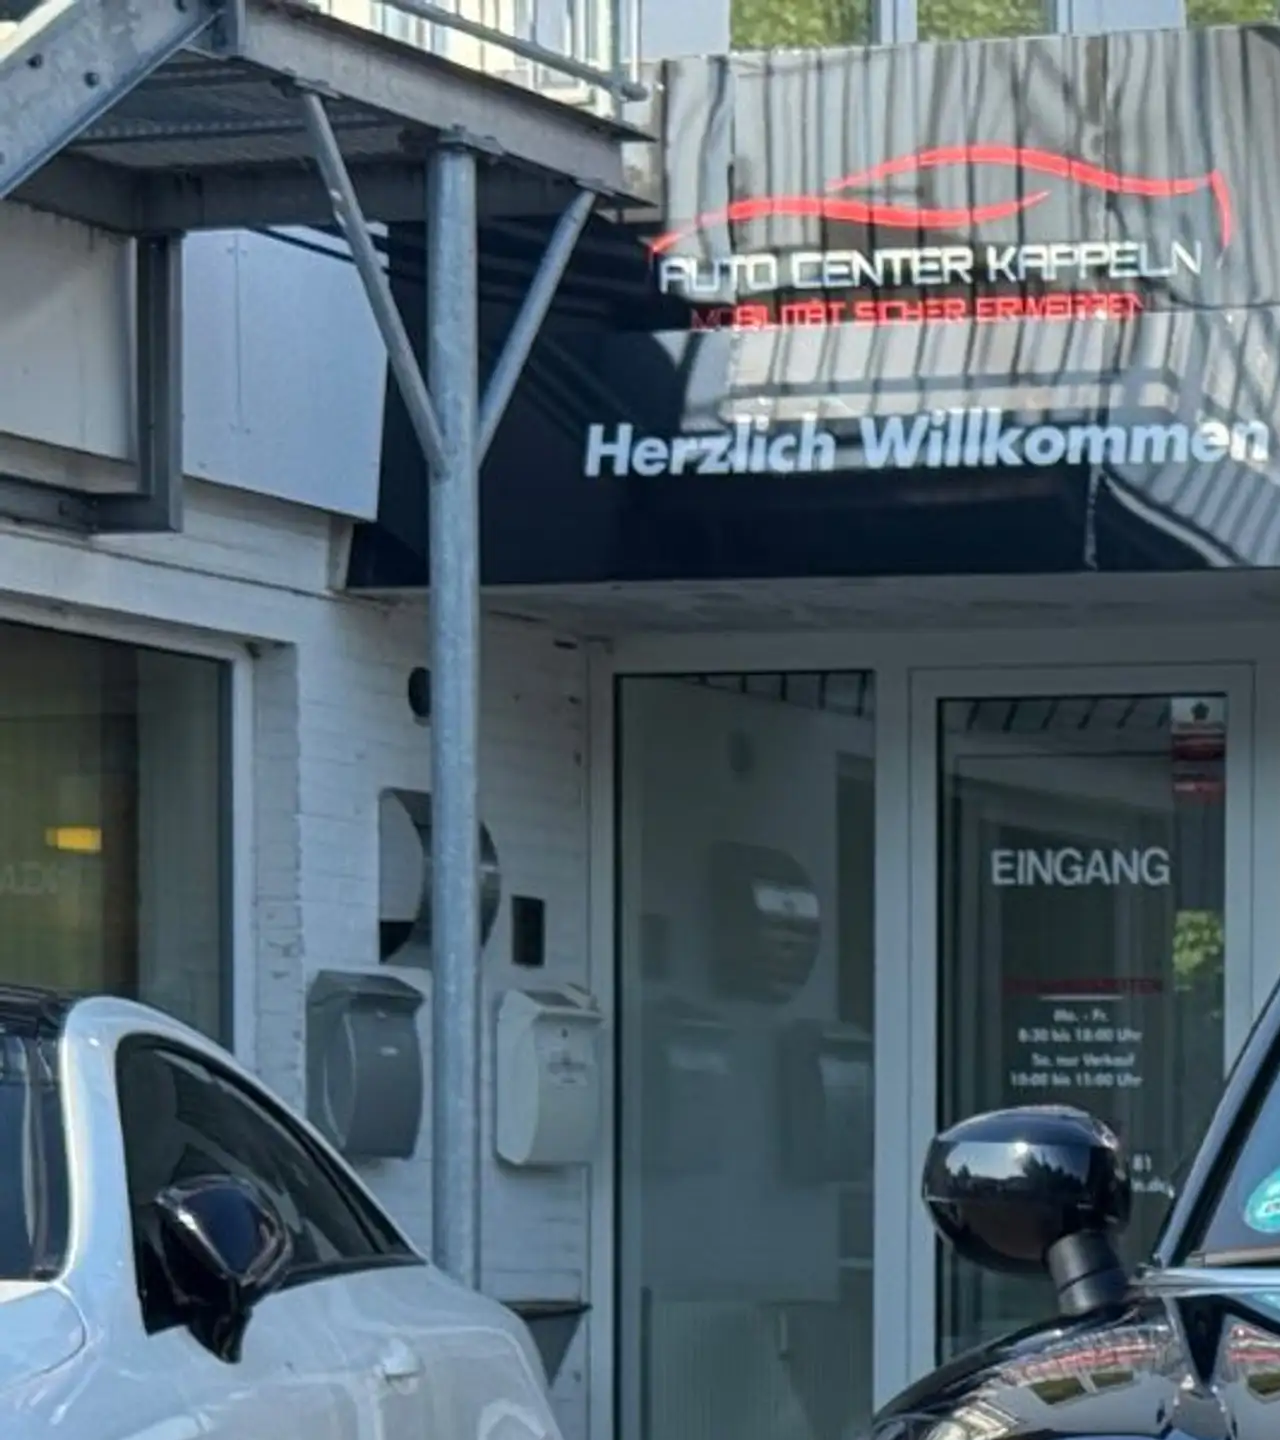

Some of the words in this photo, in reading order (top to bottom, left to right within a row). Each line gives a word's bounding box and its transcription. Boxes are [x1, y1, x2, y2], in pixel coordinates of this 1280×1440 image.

[659, 253, 778, 294] AUTO
[790, 246, 974, 289] CENTER
[987, 241, 1202, 284] KAPPELN
[855, 296, 971, 326] SICHER
[585, 413, 836, 477] Herzlich
[861, 409, 1269, 472] Willkommen
[990, 848, 1171, 886] EINGANG
